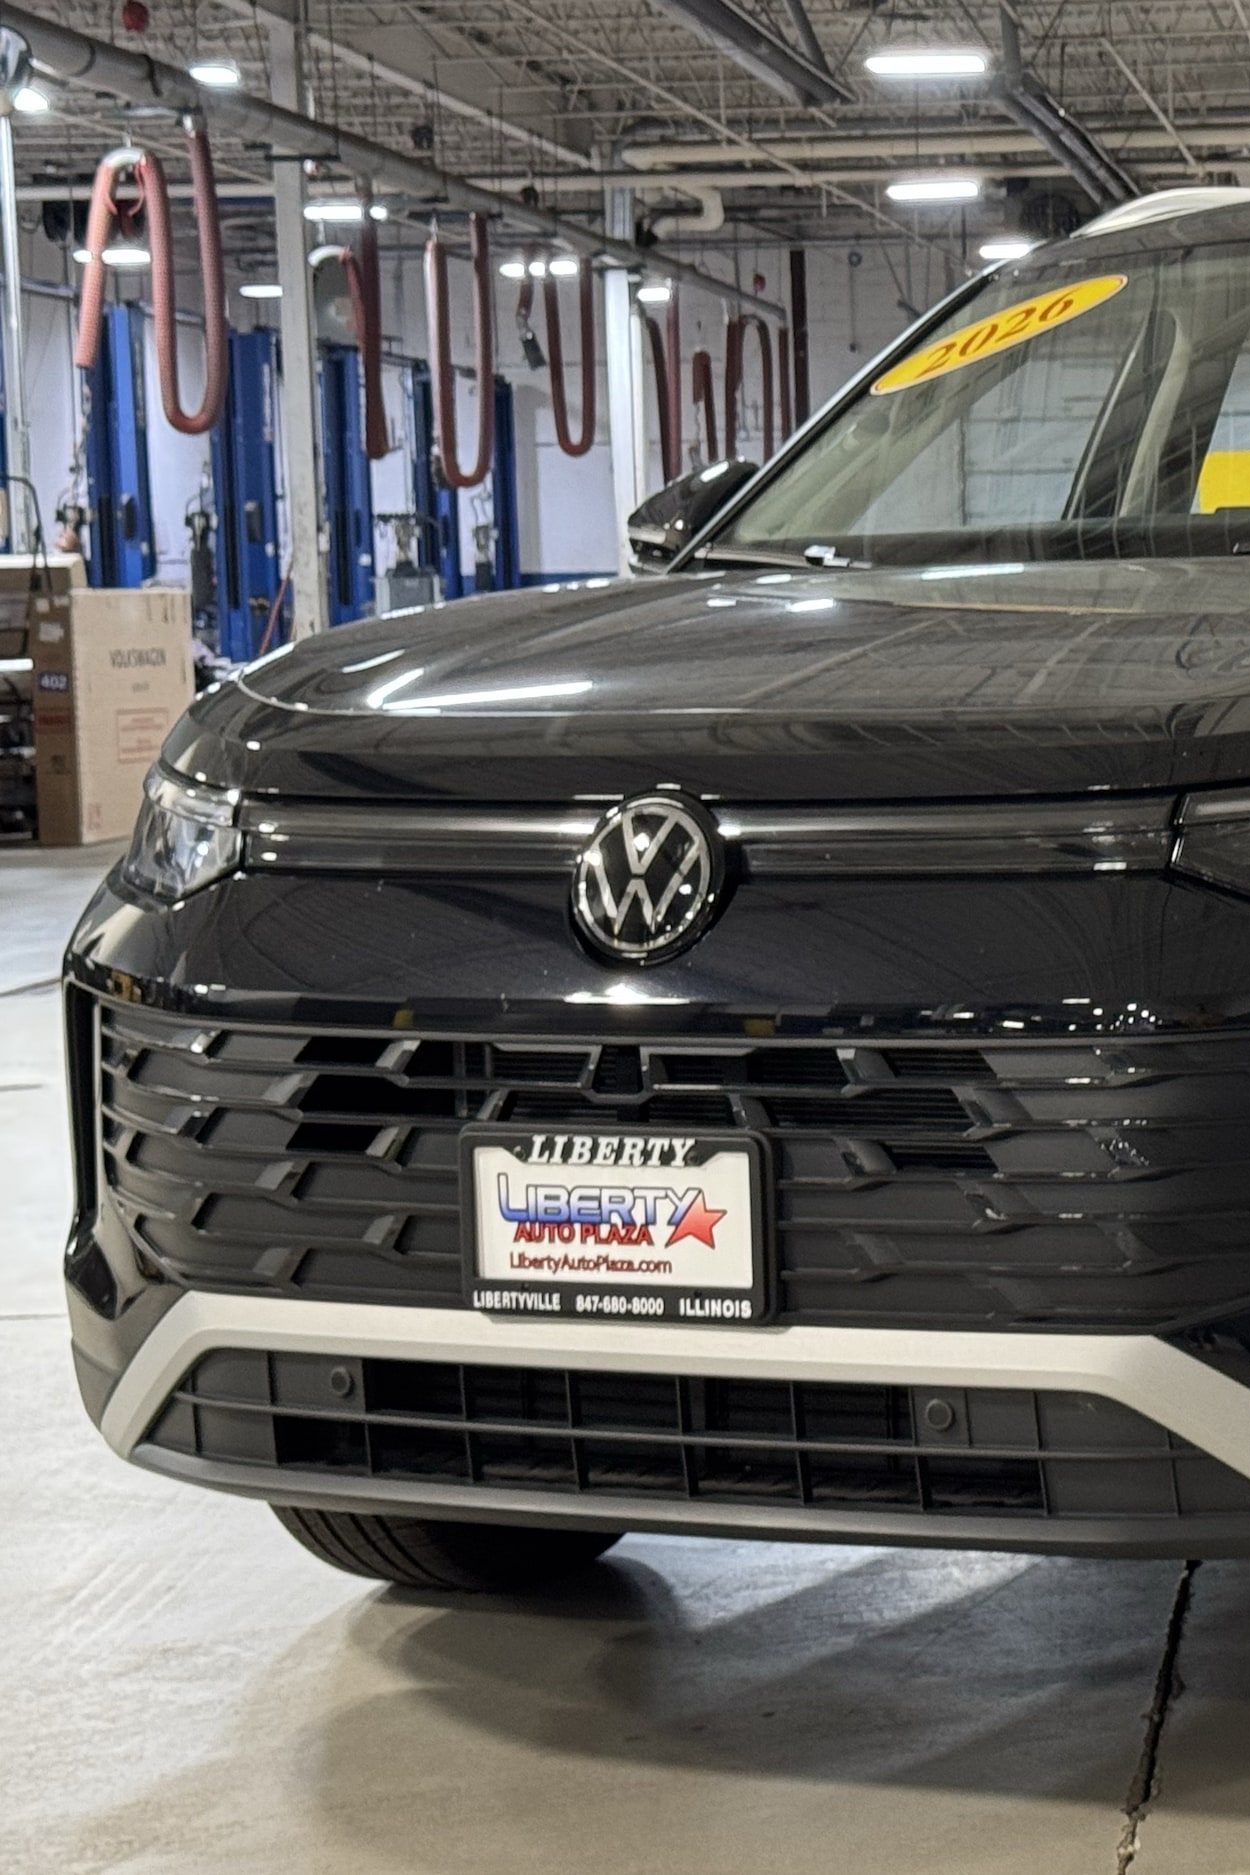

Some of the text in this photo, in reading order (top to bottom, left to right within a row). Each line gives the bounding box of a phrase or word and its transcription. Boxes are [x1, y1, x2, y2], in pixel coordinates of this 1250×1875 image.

[914, 287, 1082, 378] 2026
[527, 1134, 695, 1167] LIBERTY
[497, 1172, 703, 1226] LIBERTY
[513, 1222, 655, 1246] AUTO PLAZA
[510, 1251, 672, 1275] LibertyAutoPlaza.com
[473, 1289, 752, 1319] LIBERTYVILLE 847-680-8000 ILLINOIS
